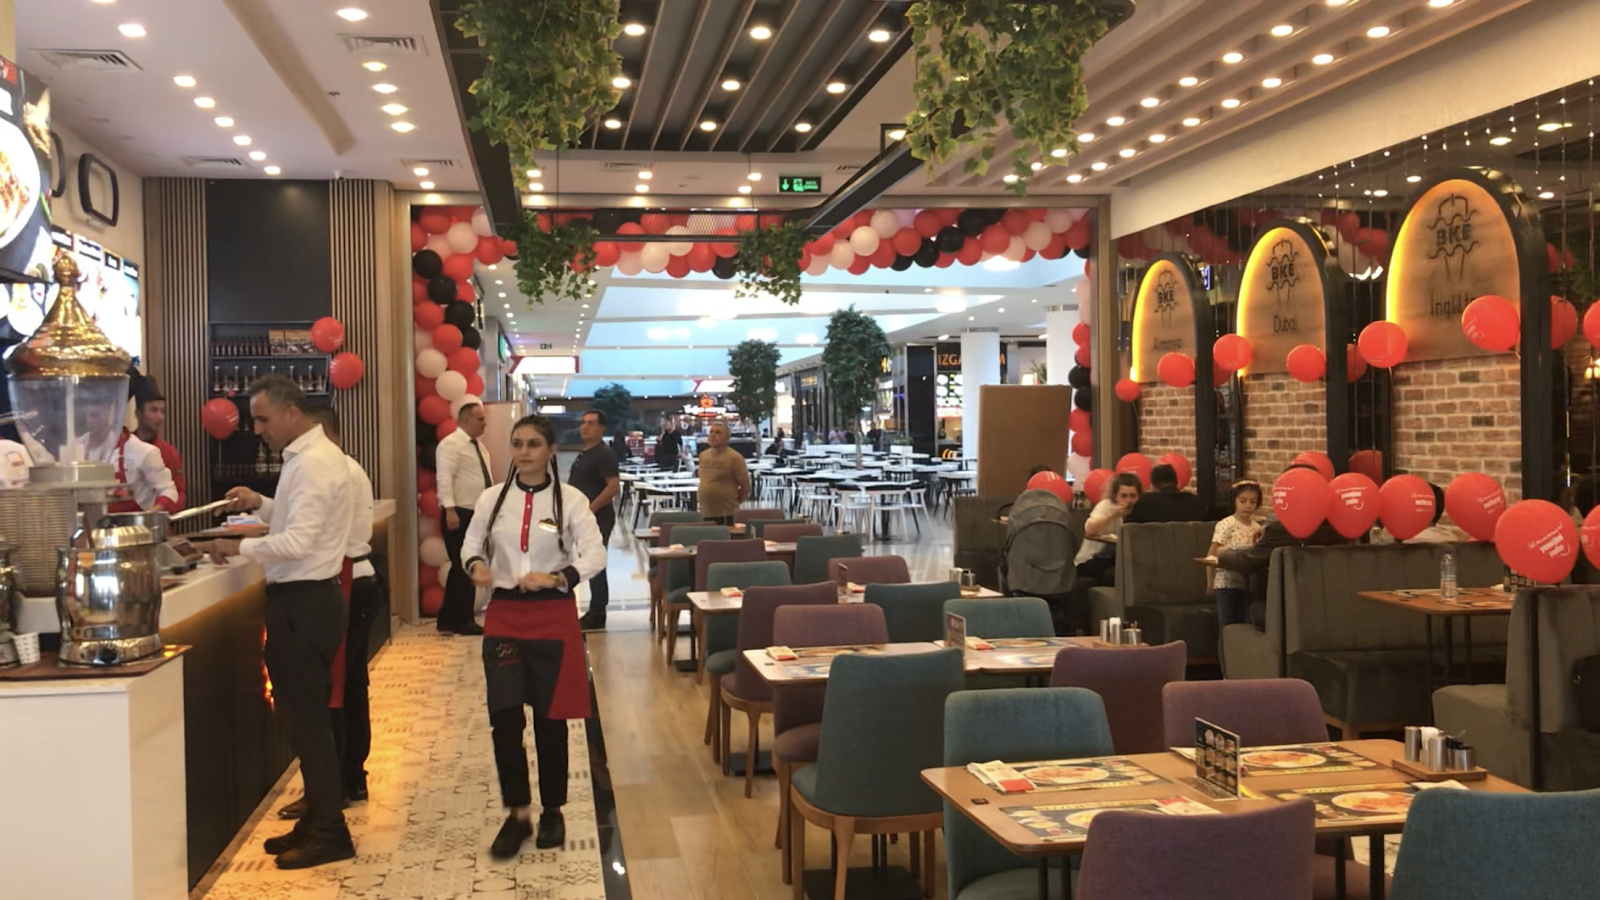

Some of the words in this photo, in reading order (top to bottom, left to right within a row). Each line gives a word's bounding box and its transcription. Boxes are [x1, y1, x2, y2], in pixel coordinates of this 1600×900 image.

[1436, 223, 1472, 247] BKE
[1271, 262, 1295, 281] BKE
[1157, 289, 1175, 304] BKE
